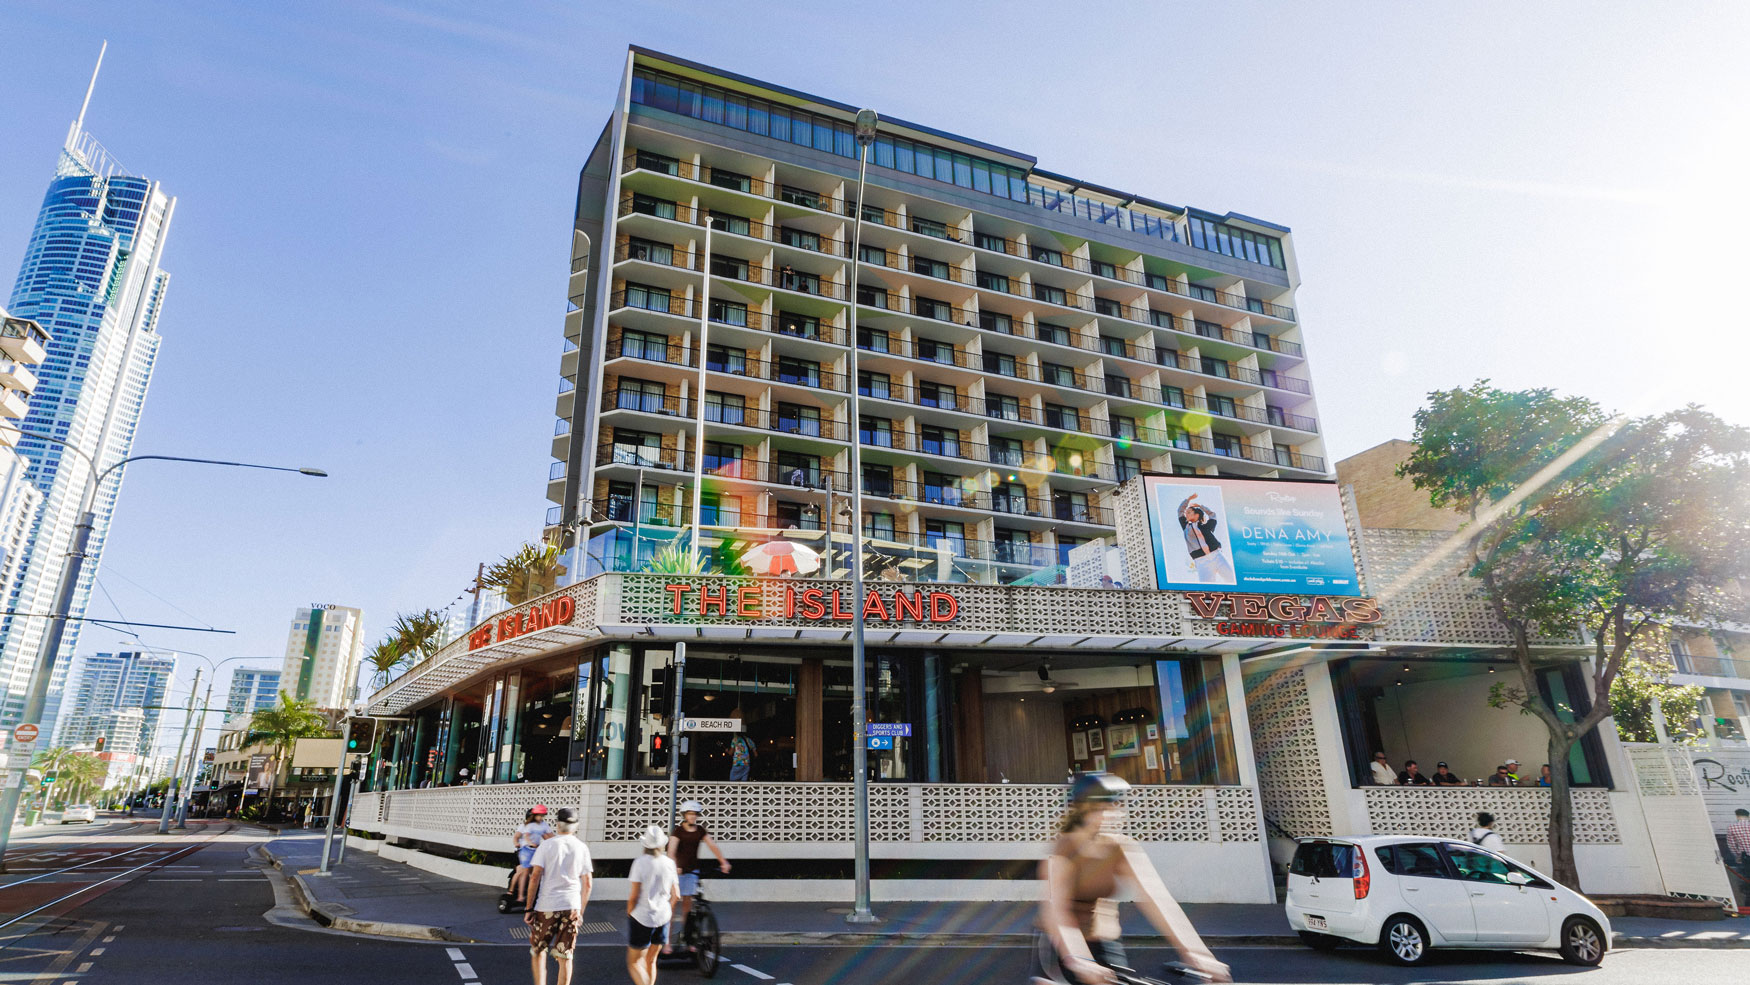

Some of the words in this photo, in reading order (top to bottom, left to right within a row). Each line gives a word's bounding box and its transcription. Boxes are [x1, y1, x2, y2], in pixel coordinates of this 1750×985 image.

[1242, 526, 1289, 540] DENA
[1295, 528, 1332, 541] AMY
[665, 584, 763, 617] THE
[785, 586, 959, 623] ISLAND
[1185, 592, 1382, 623] VEGAS
[468, 623, 493, 651] THE
[497, 595, 576, 643] ISLAND
[1216, 621, 1285, 637] GAMING
[1290, 623, 1360, 639] LOUNGE
[700, 720, 722, 728] BEACH
[723, 721, 733, 729] RD
